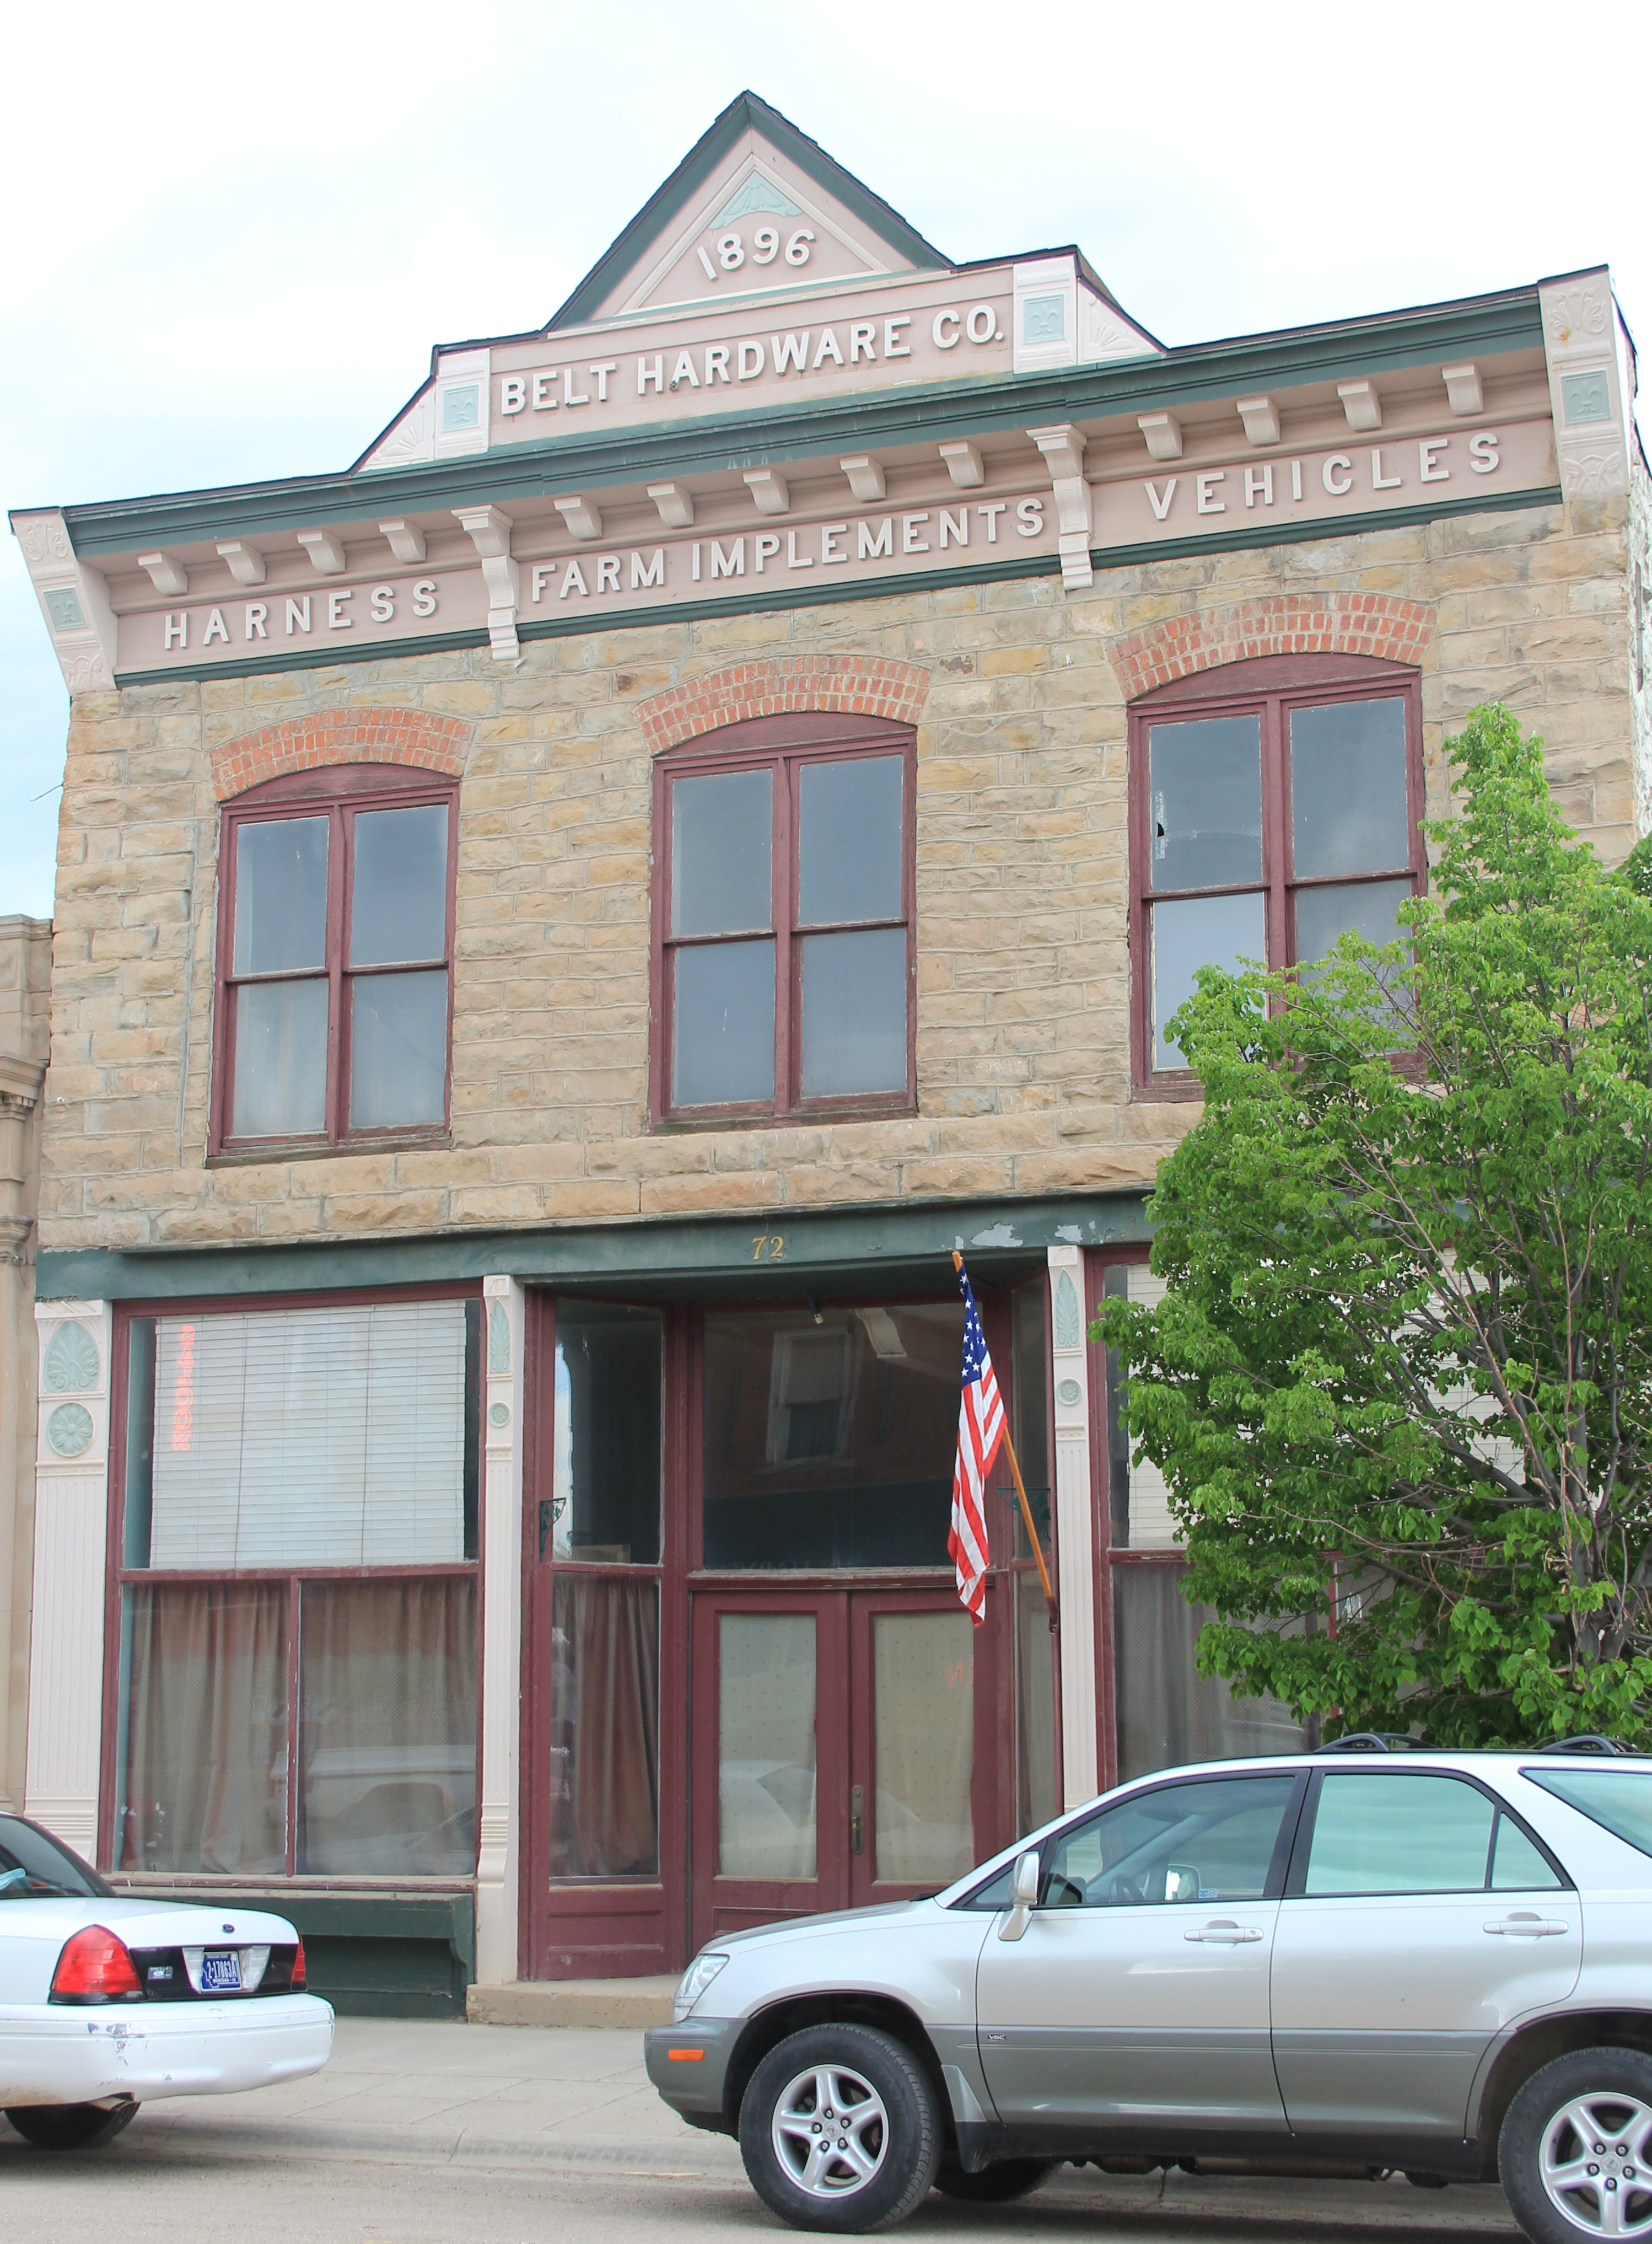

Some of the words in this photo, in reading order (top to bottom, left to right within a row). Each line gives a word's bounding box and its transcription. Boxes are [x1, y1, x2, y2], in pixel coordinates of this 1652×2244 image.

[697, 227, 817, 281] 1896
[501, 362, 617, 416] BELT
[637, 316, 911, 395] HARDWARE
[932, 305, 1005, 349] CO.
[1144, 432, 1500, 521] VEHICLES
[532, 549, 665, 603] FARM
[692, 498, 1044, 581] IMPLEMENTS
[165, 580, 437, 649] HARNESS
[751, 1236, 785, 1261] 72
